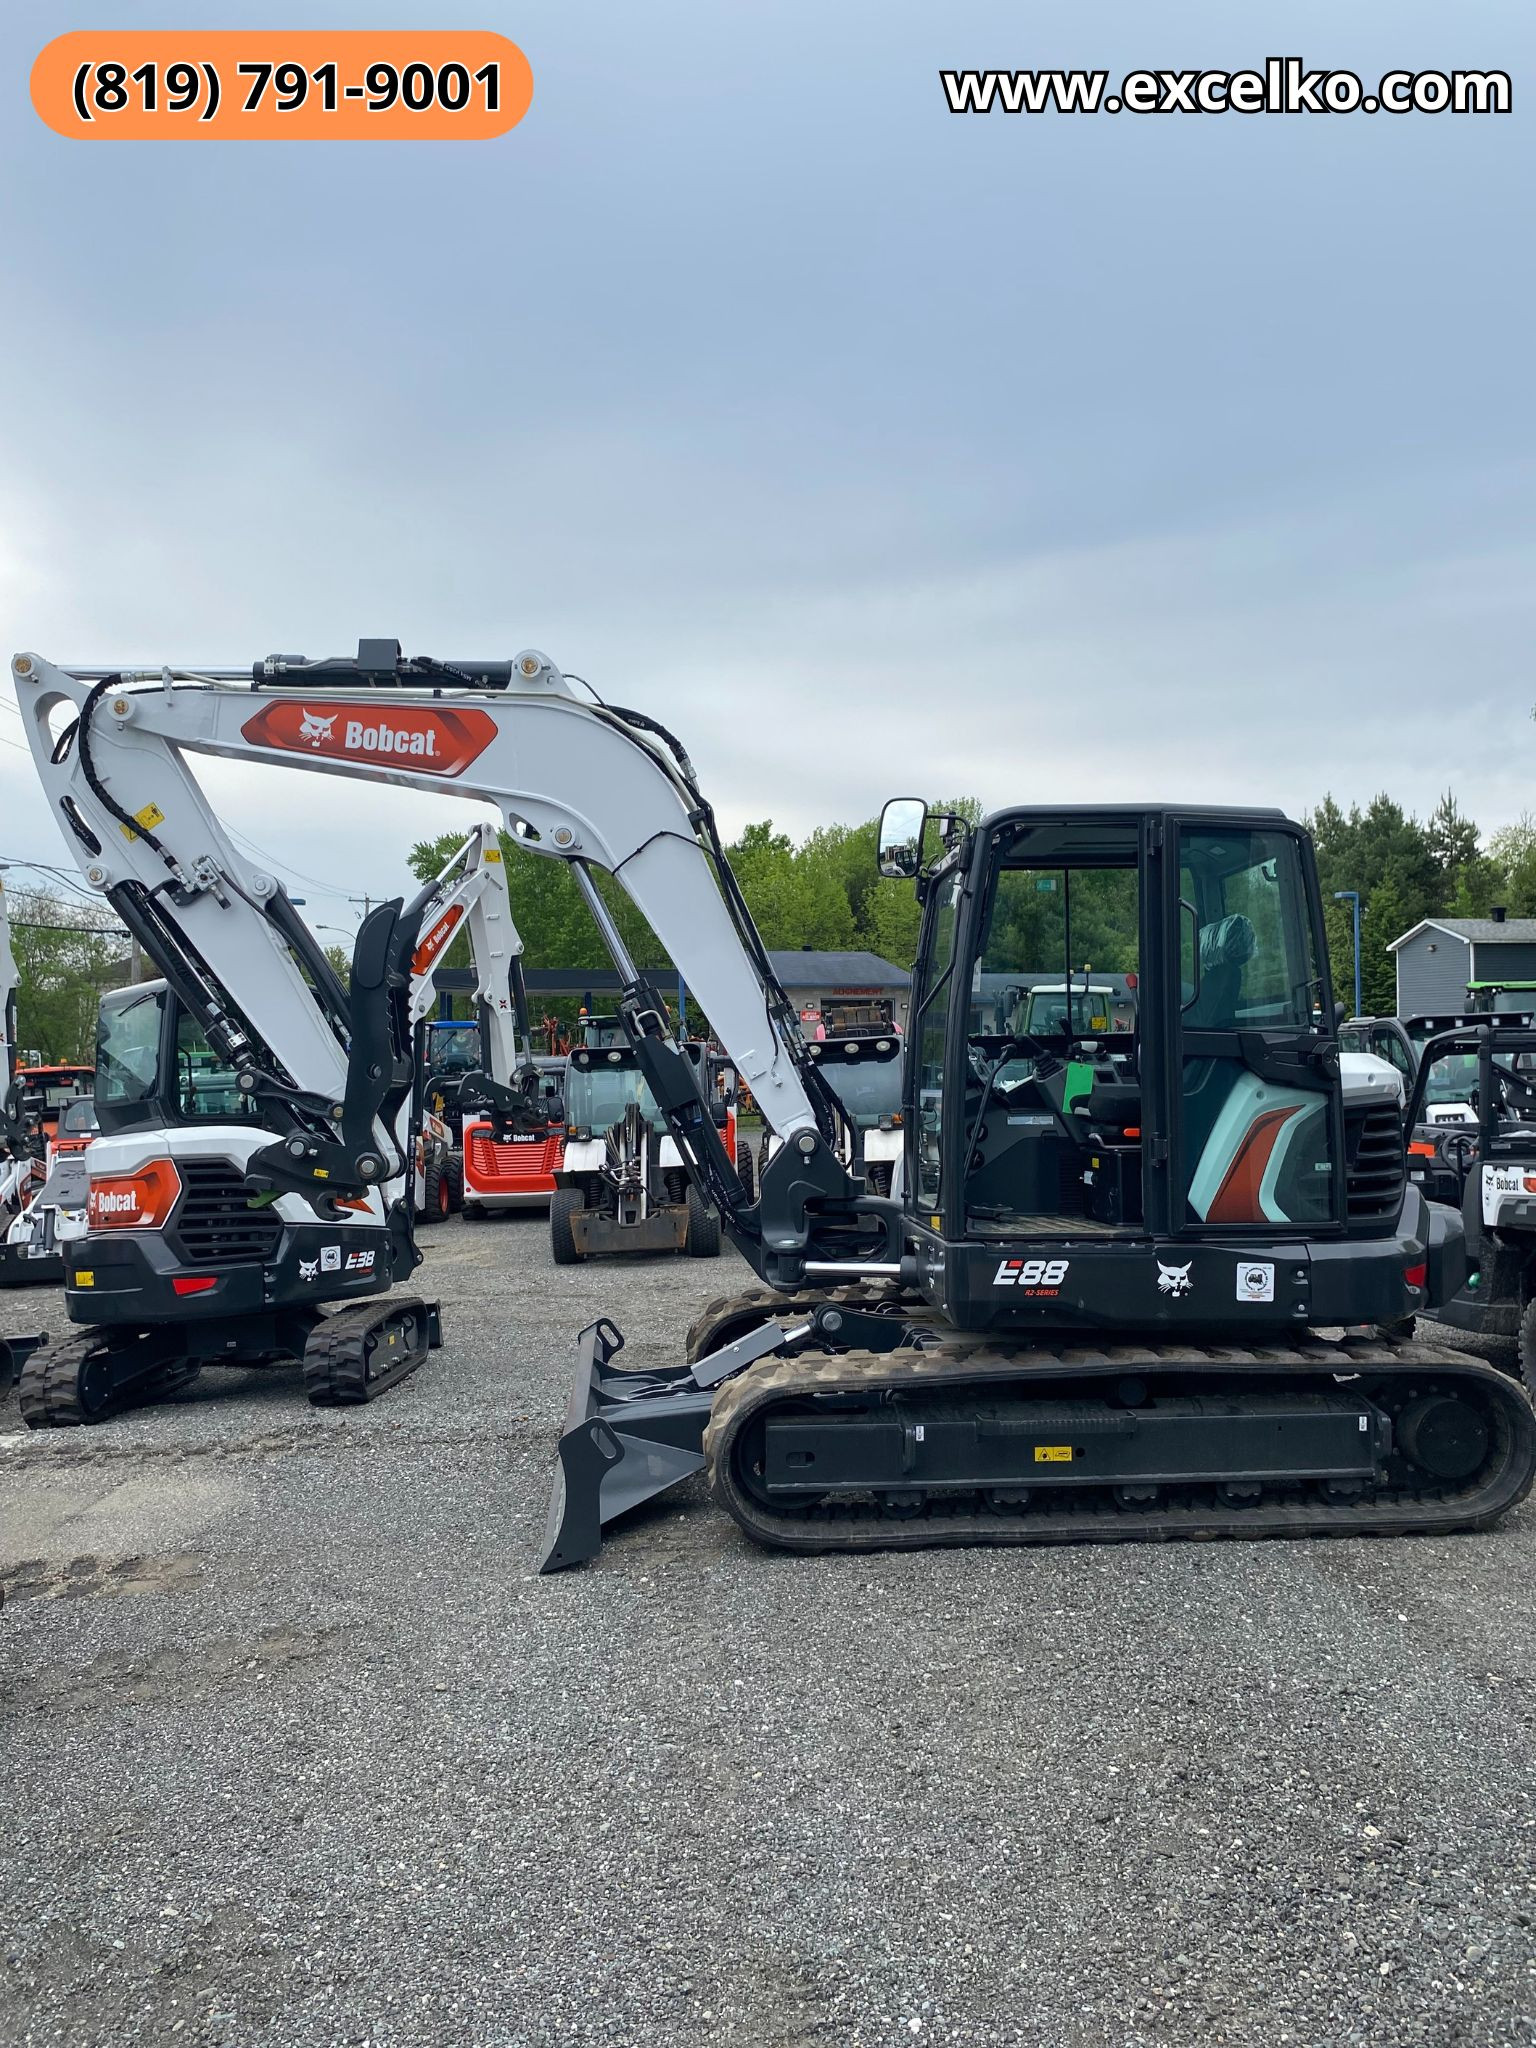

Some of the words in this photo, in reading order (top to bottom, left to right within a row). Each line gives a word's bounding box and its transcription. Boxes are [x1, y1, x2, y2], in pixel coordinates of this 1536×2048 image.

[345, 721, 436, 757] Bobcat
[512, 1133, 536, 1142] Bobcat
[1496, 1177, 1519, 1191] Bobcat
[98, 1190, 137, 1213] Bobcat
[344, 1250, 376, 1270] E38
[992, 1260, 1070, 1286] E88
[1024, 1289, 1060, 1297] R2-SERIES
